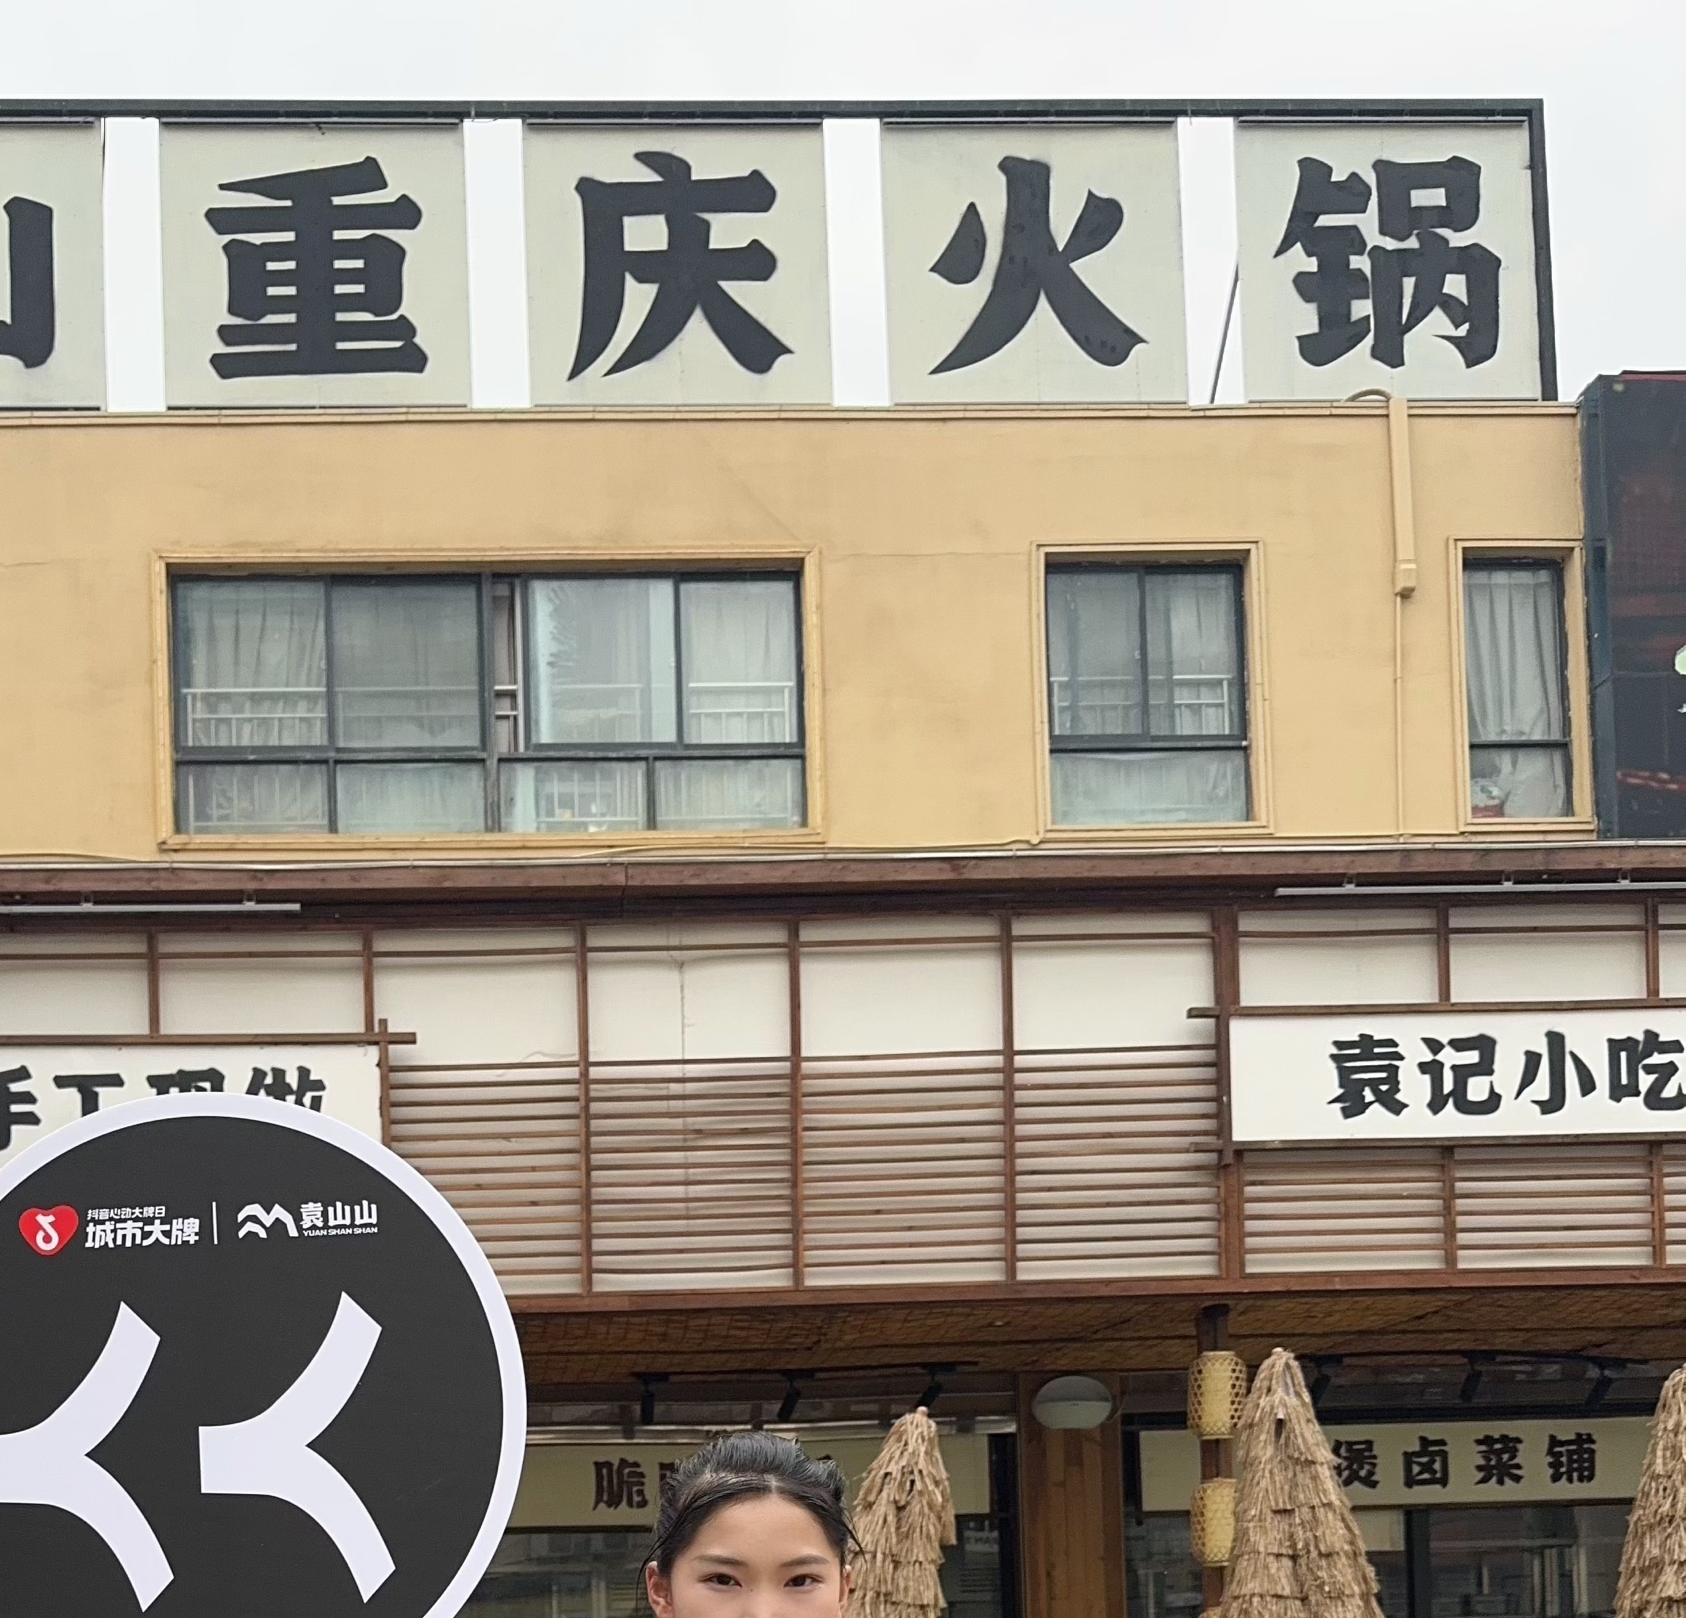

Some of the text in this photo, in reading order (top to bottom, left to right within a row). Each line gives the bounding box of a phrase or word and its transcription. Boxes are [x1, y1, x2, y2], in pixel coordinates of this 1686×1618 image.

[1325, 1028, 1686, 1120] 袁记小吃
[86, 1206, 166, 1220] 抖音心动大牌日
[299, 1200, 379, 1230] 袁山山
[84, 1216, 201, 1249] 城市大牌
[302, 1226, 379, 1238] YUAN SHAN SHAN
